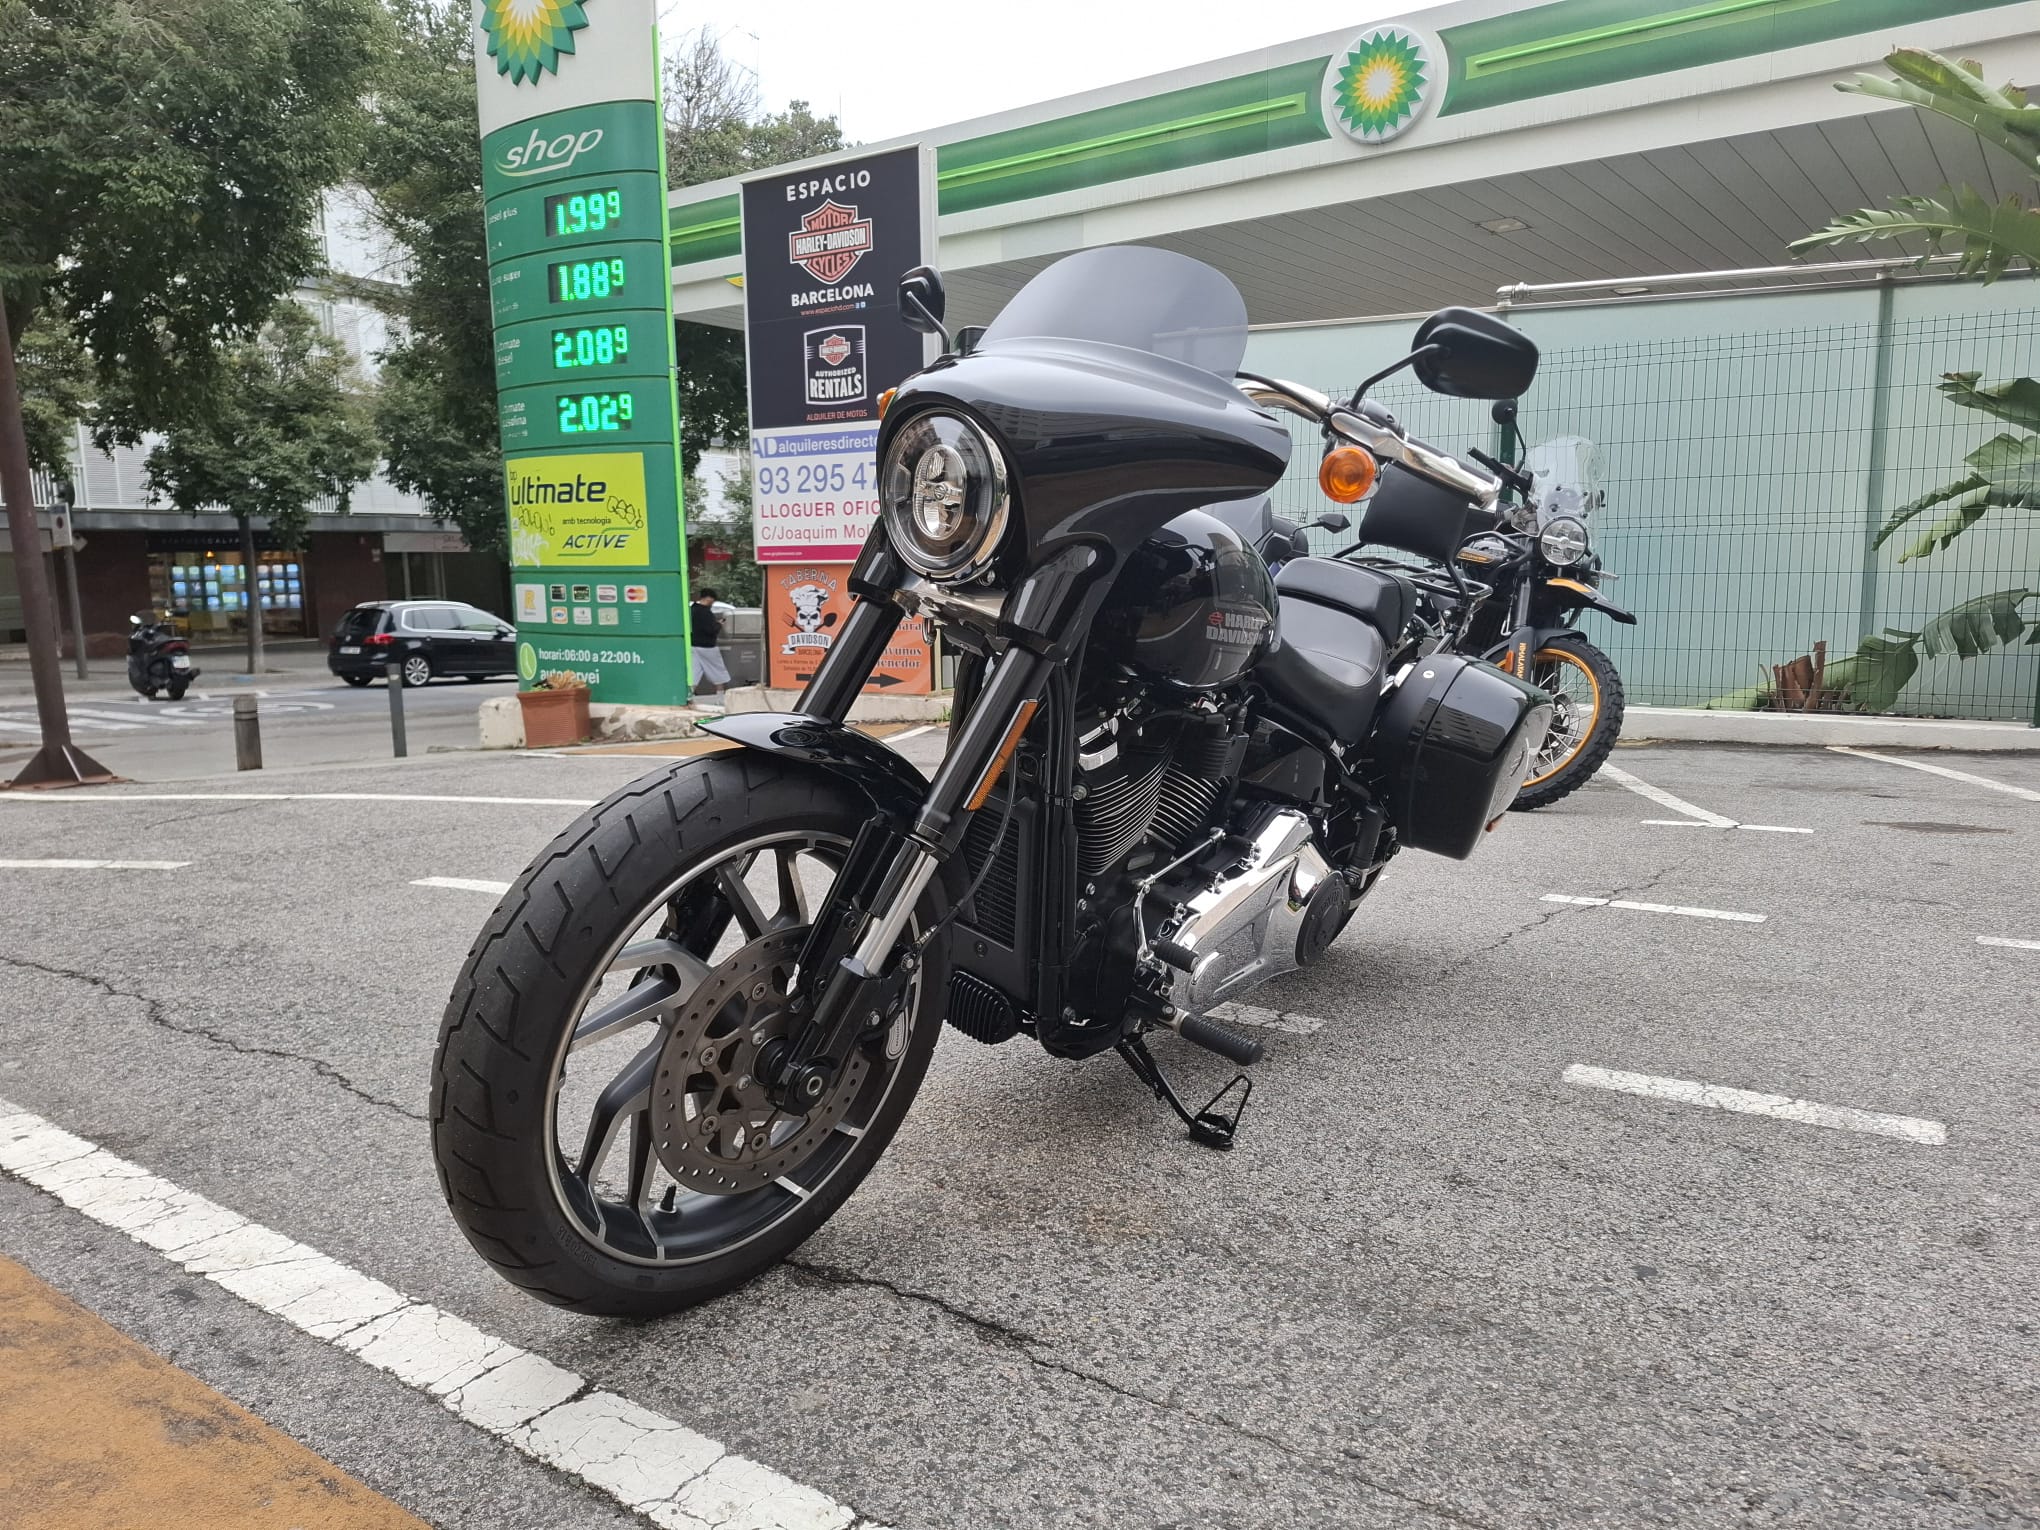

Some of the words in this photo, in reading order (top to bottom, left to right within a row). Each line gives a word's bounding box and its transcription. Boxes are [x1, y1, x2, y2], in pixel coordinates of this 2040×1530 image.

[503, 129, 603, 170] shop
[786, 170, 871, 201] ESPACIO
[556, 190, 621, 235] 1.999
[811, 209, 849, 231] MOTOR
[796, 227, 866, 255] HARLEY-DAVIDSON
[812, 252, 850, 276] CYCLES
[559, 258, 624, 301] 1.889
[791, 283, 874, 306] BARCELONA
[554, 326, 628, 369] 2.089
[815, 367, 857, 377] AUTHORIZED
[810, 374, 862, 398] RENTALS
[558, 393, 632, 432] 2.029
[807, 412, 836, 421] ALQUILER
[837, 410, 846, 419] DE
[846, 409, 868, 418] MOTOS
[511, 474, 607, 505] ultimate
[759, 466, 790, 495] 93
[797, 463, 845, 494] 295
[562, 517, 575, 525] amb
[761, 502, 835, 518] LLOGUER
[562, 534, 630, 549] ACTIVE
[761, 525, 837, 543] C/Joaquim
[781, 568, 838, 592] TABERNA
[791, 634, 830, 647] DAVIDSON
[1206, 625, 1264, 645] DAVIDSON
[592, 653, 599, 662] a
[600, 650, 631, 664] 22:00
[632, 651, 645, 664] h.
